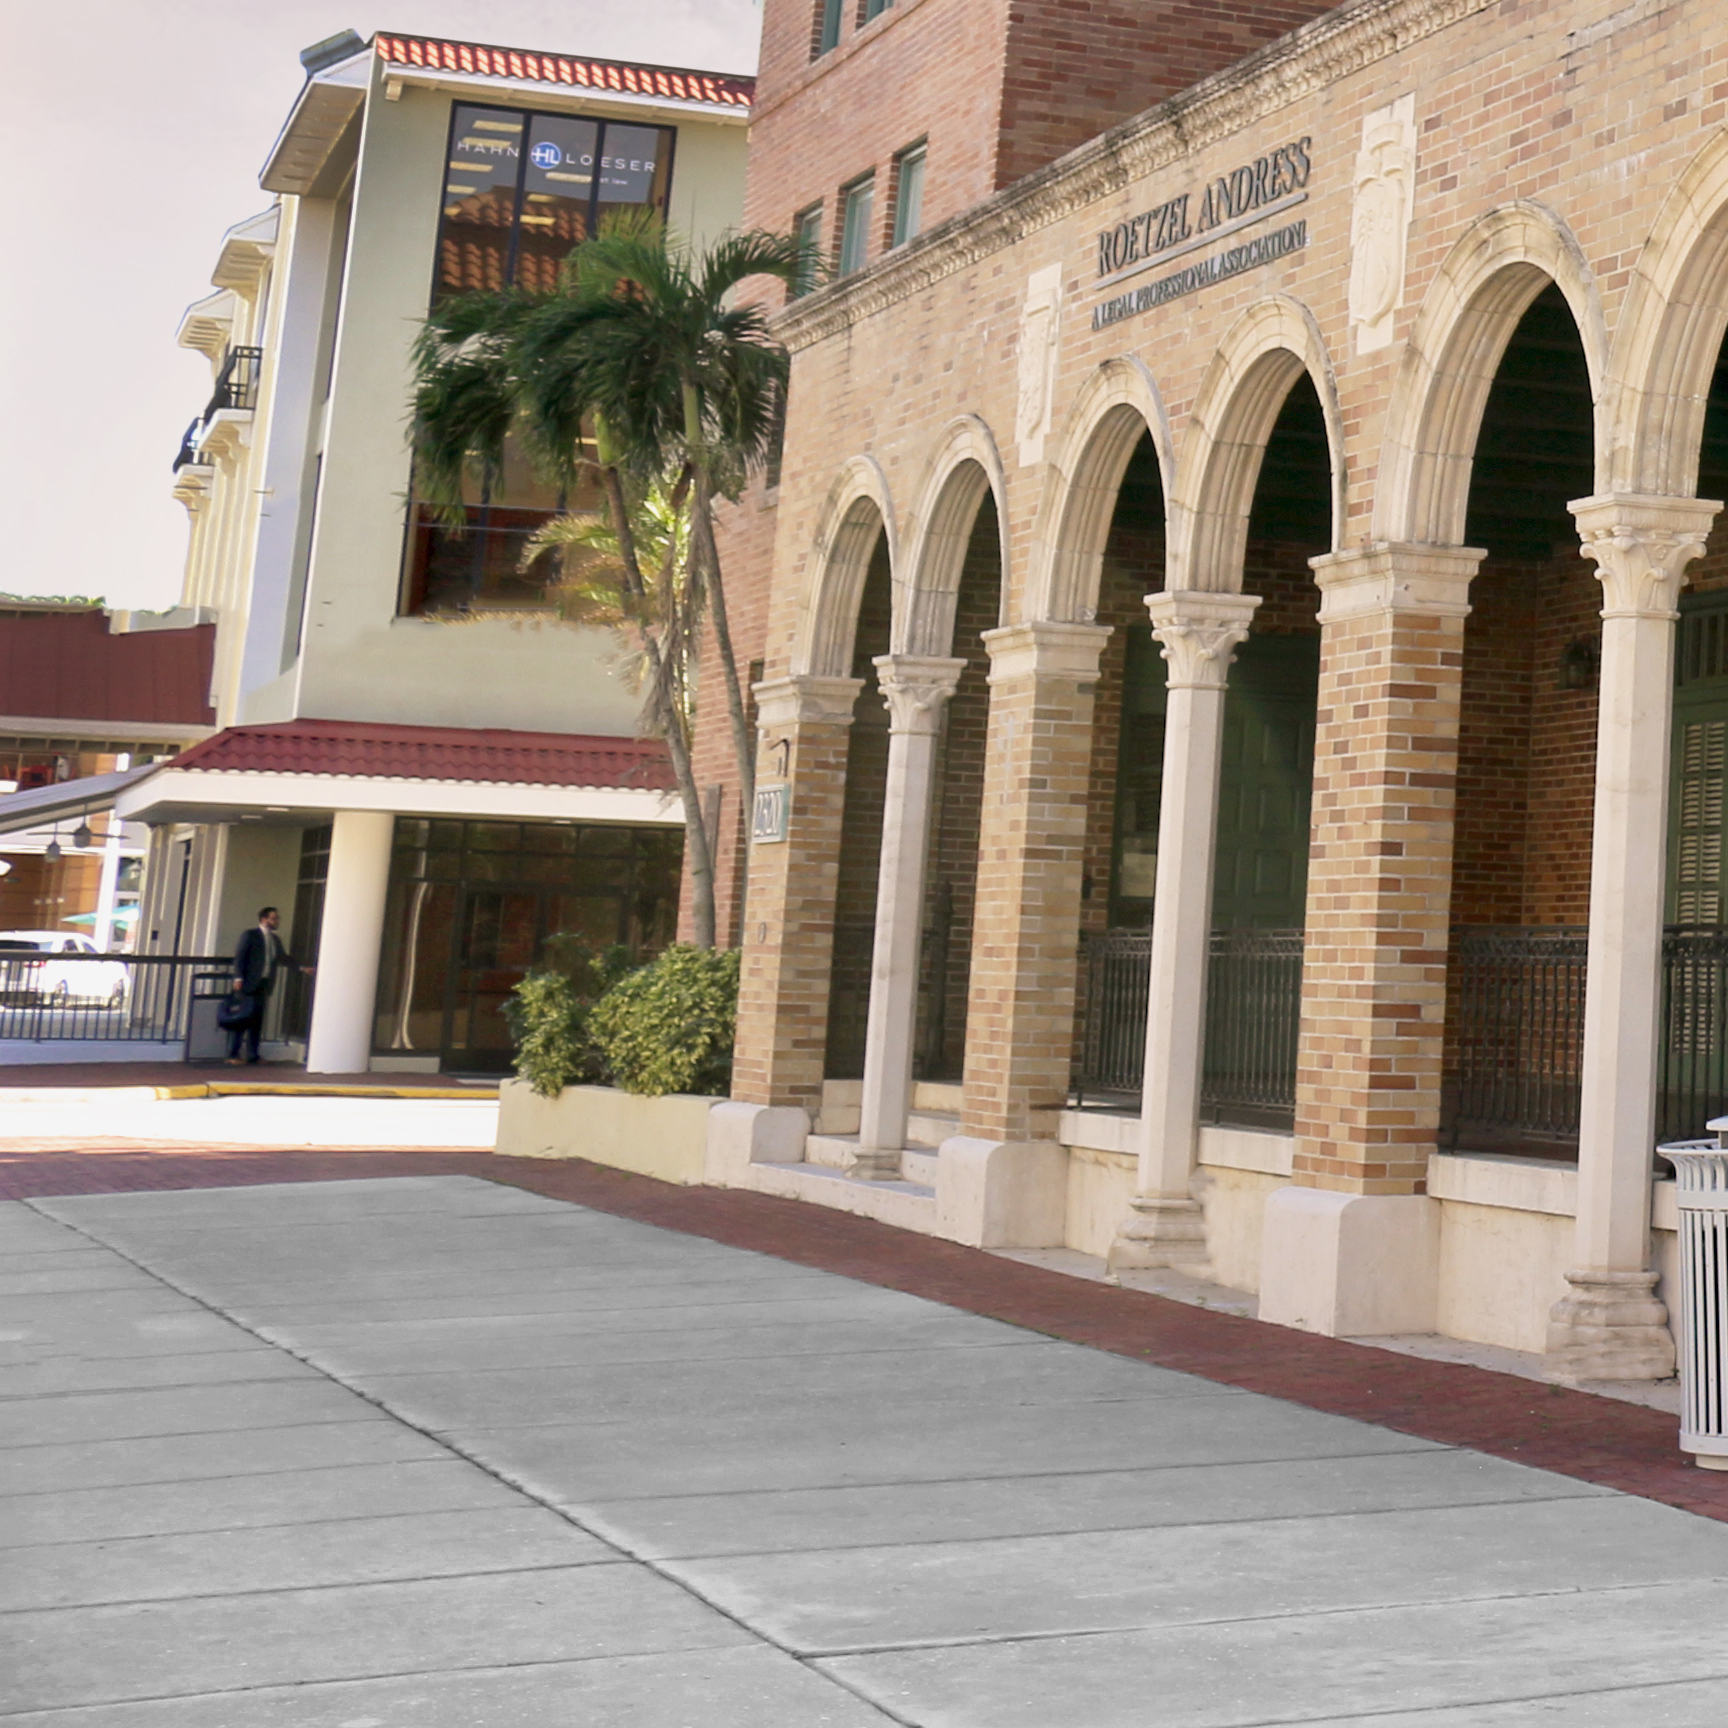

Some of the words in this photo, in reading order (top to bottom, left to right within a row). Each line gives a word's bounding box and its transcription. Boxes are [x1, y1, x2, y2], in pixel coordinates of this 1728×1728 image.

[456, 141, 519, 157] HAHN
[565, 153, 656, 172] LOESER
[1097, 193, 1192, 278] ROETZEL
[1195, 136, 1312, 233] ANDRESS
[1101, 292, 1135, 325] LEGAL
